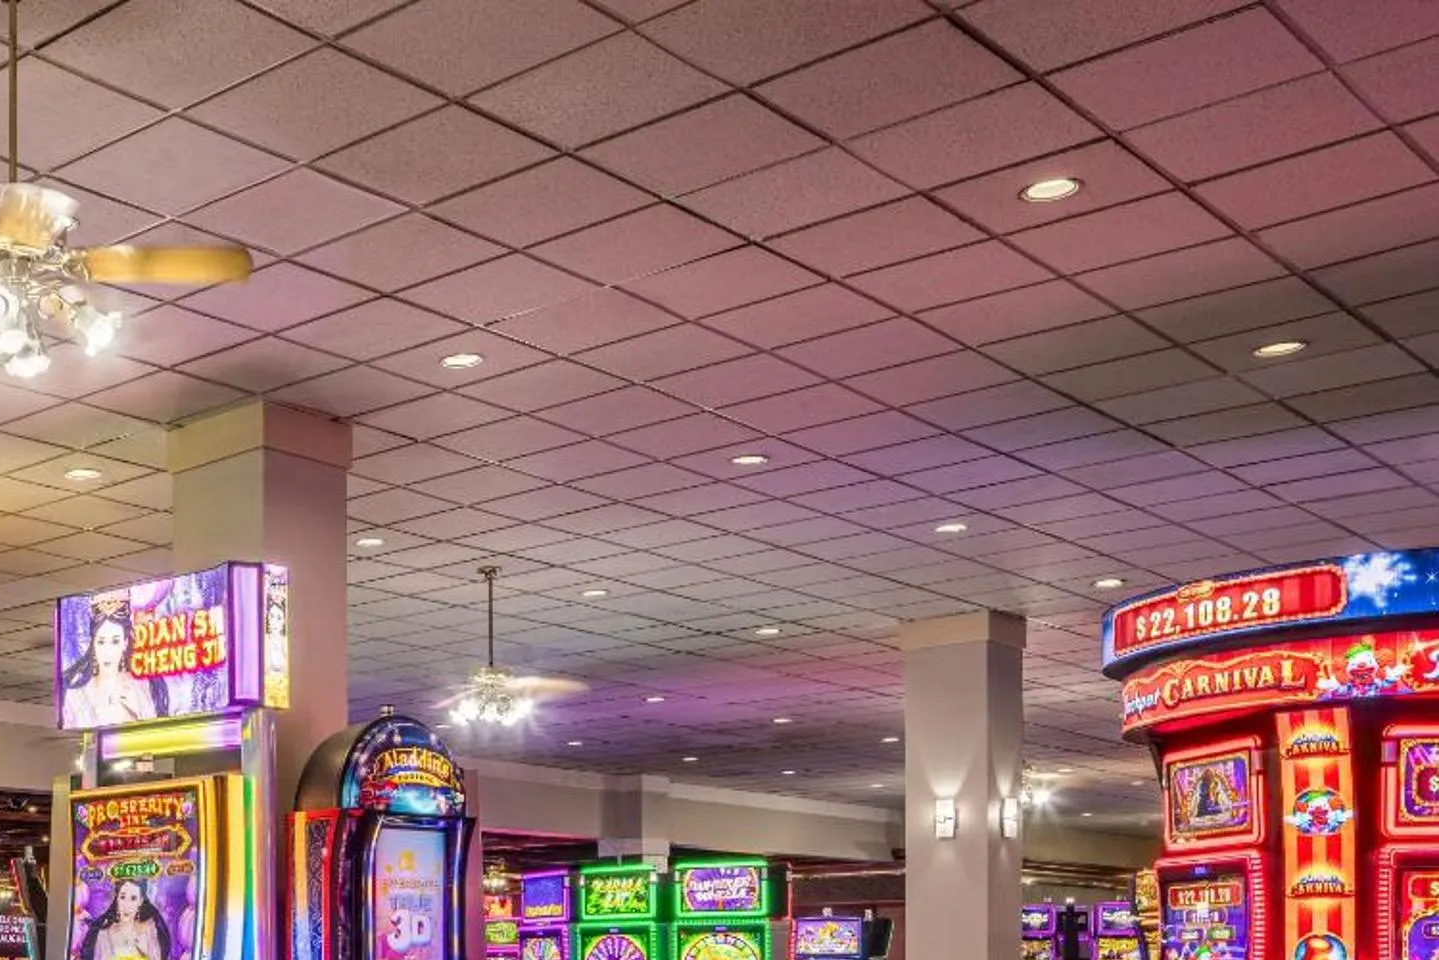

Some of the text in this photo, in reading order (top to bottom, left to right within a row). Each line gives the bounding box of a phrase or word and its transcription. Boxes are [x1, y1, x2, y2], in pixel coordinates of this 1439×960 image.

[134, 613, 186, 648] DIAN
[1136, 588, 1280, 640] $22,108.28
[132, 644, 197, 676] CHENG
[1163, 659, 1306, 706] CARNIVAL
[88, 797, 185, 829] PROSPERITY
